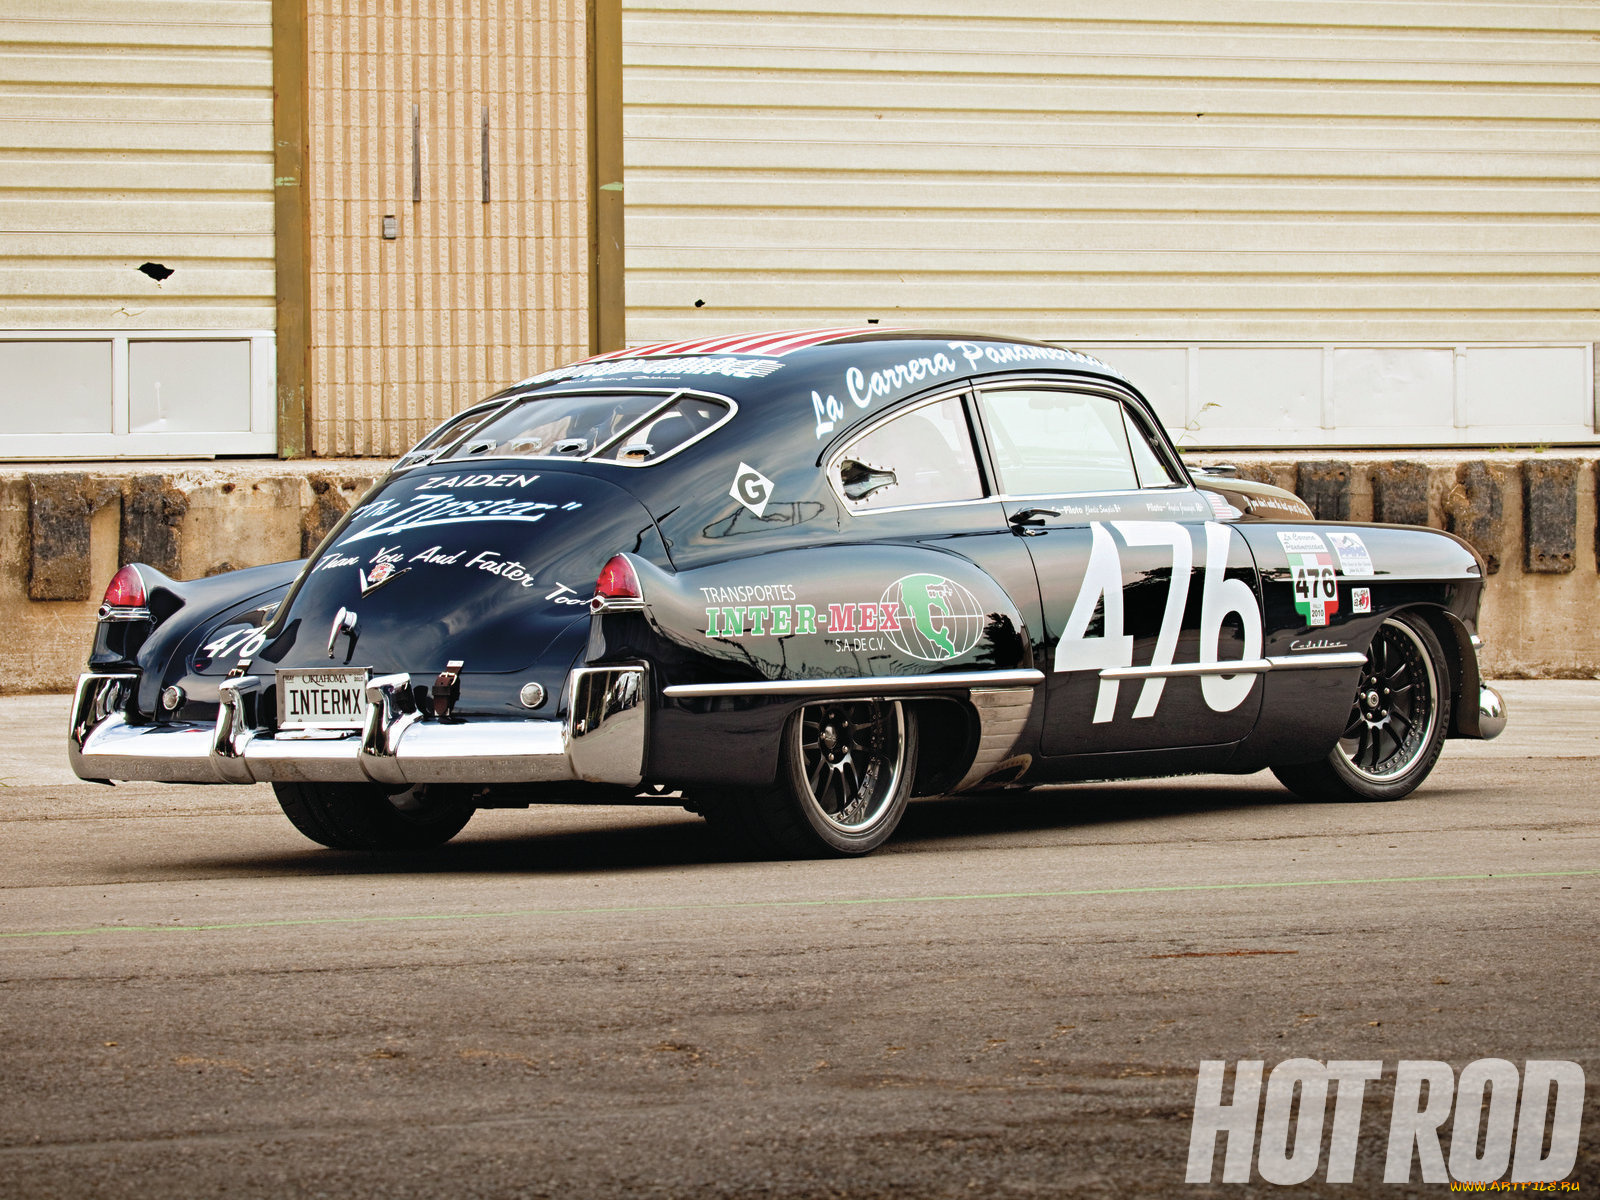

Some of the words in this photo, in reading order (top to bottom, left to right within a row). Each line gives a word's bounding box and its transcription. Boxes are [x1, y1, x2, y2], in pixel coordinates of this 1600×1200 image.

[811, 390, 844, 439] La
[845, 352, 956, 408] Carrera
[415, 474, 540, 490] ZAIDEN
[737, 472, 767, 505] G
[312, 553, 359, 574] Than
[369, 546, 403, 564] You
[409, 546, 466, 565] And
[465, 551, 534, 587] Faster
[1295, 568, 1336, 599] 476
[700, 584, 797, 603] TRANSPORTES
[705, 602, 900, 637] INTER-MEX
[1054, 521, 1263, 724] 476
[203, 620, 275, 658] 476
[290, 689, 362, 715] INTERMX
